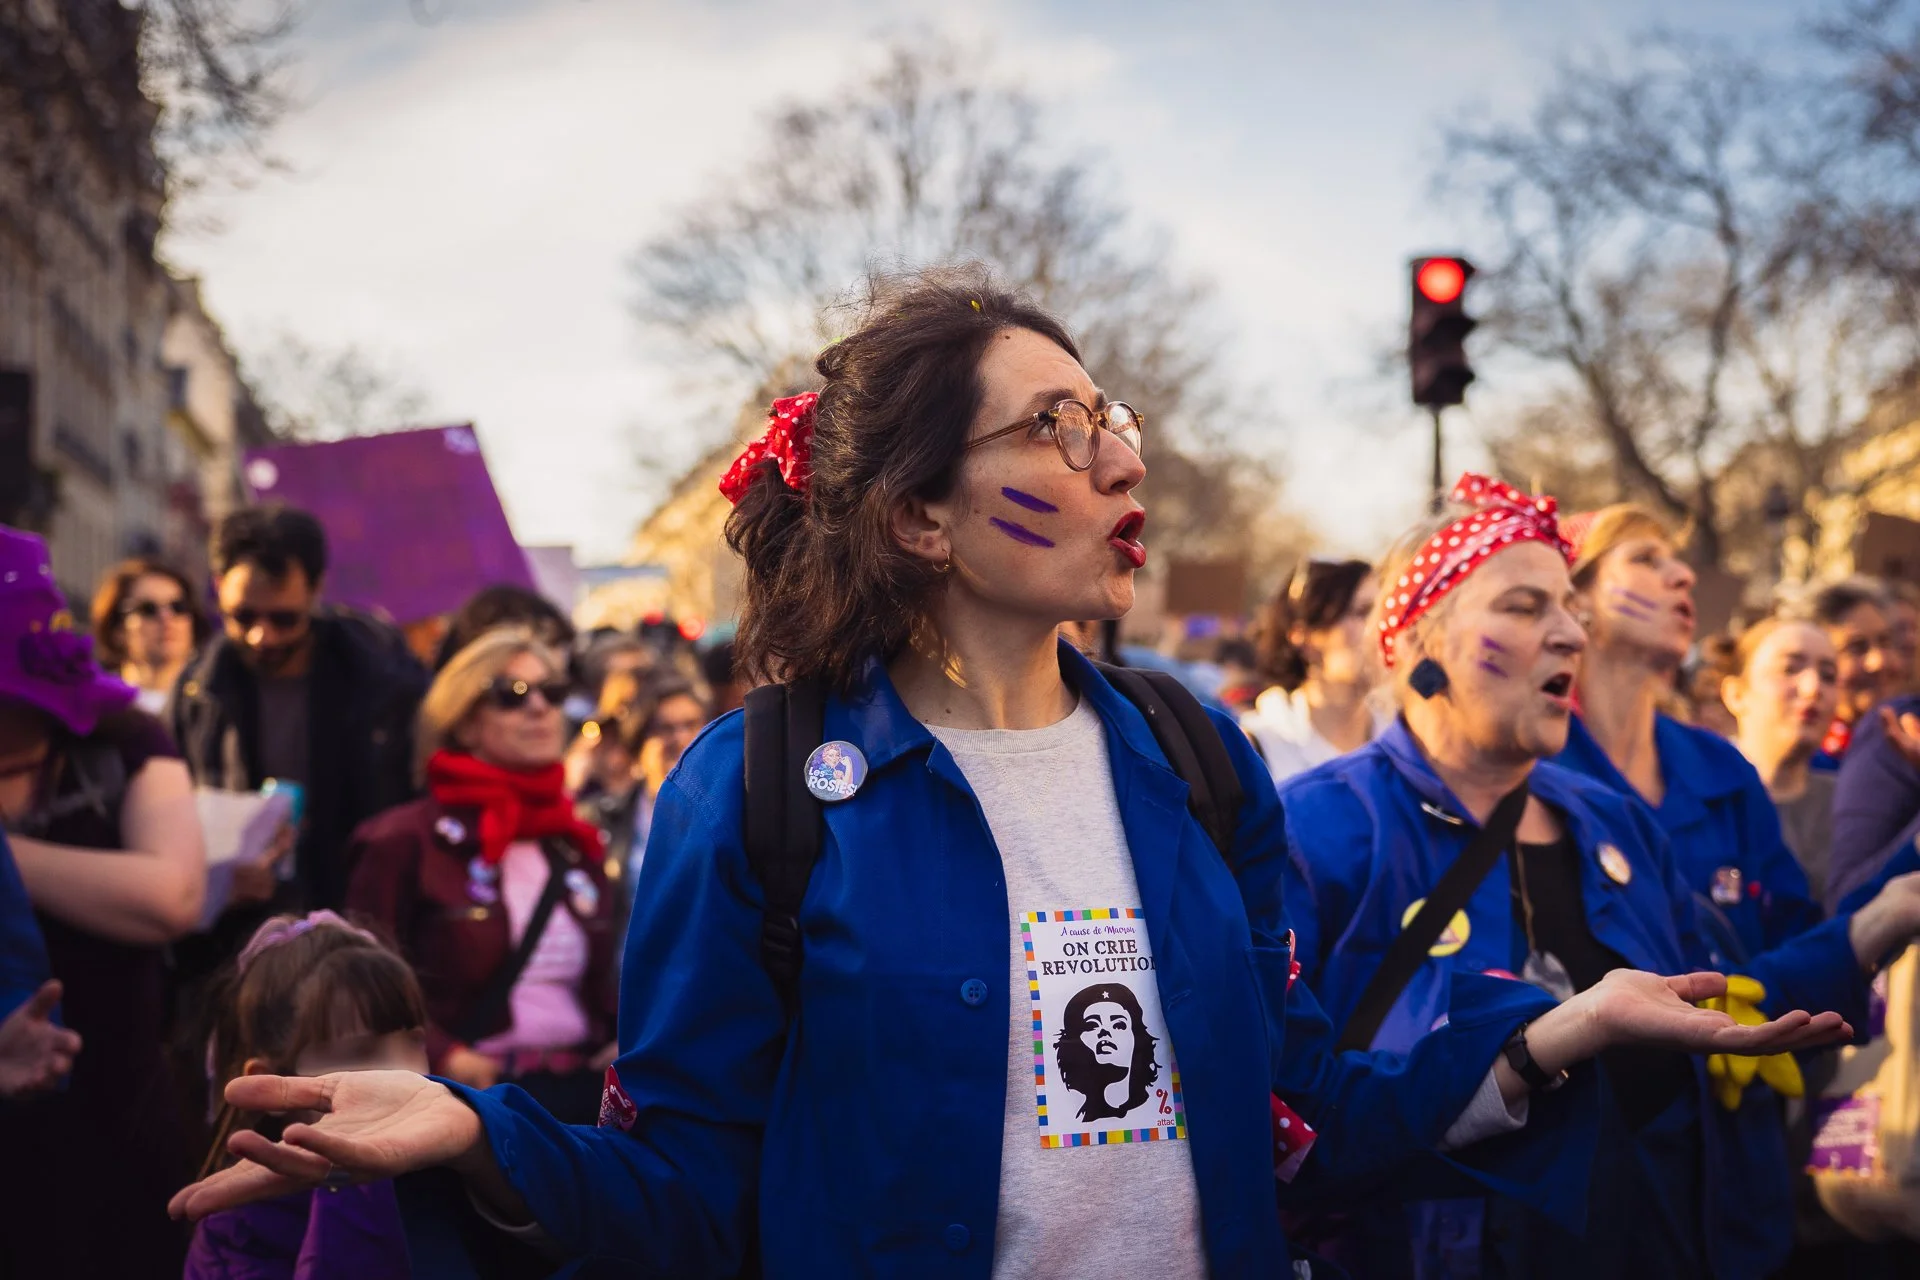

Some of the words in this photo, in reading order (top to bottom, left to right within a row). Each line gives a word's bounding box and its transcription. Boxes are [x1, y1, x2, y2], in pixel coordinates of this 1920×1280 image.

[808, 767, 825, 777] Les
[1069, 928, 1091, 936] cause
[1093, 925, 1102, 935] de
[1062, 941, 1089, 957] ON
[1094, 939, 1138, 955] CRIE
